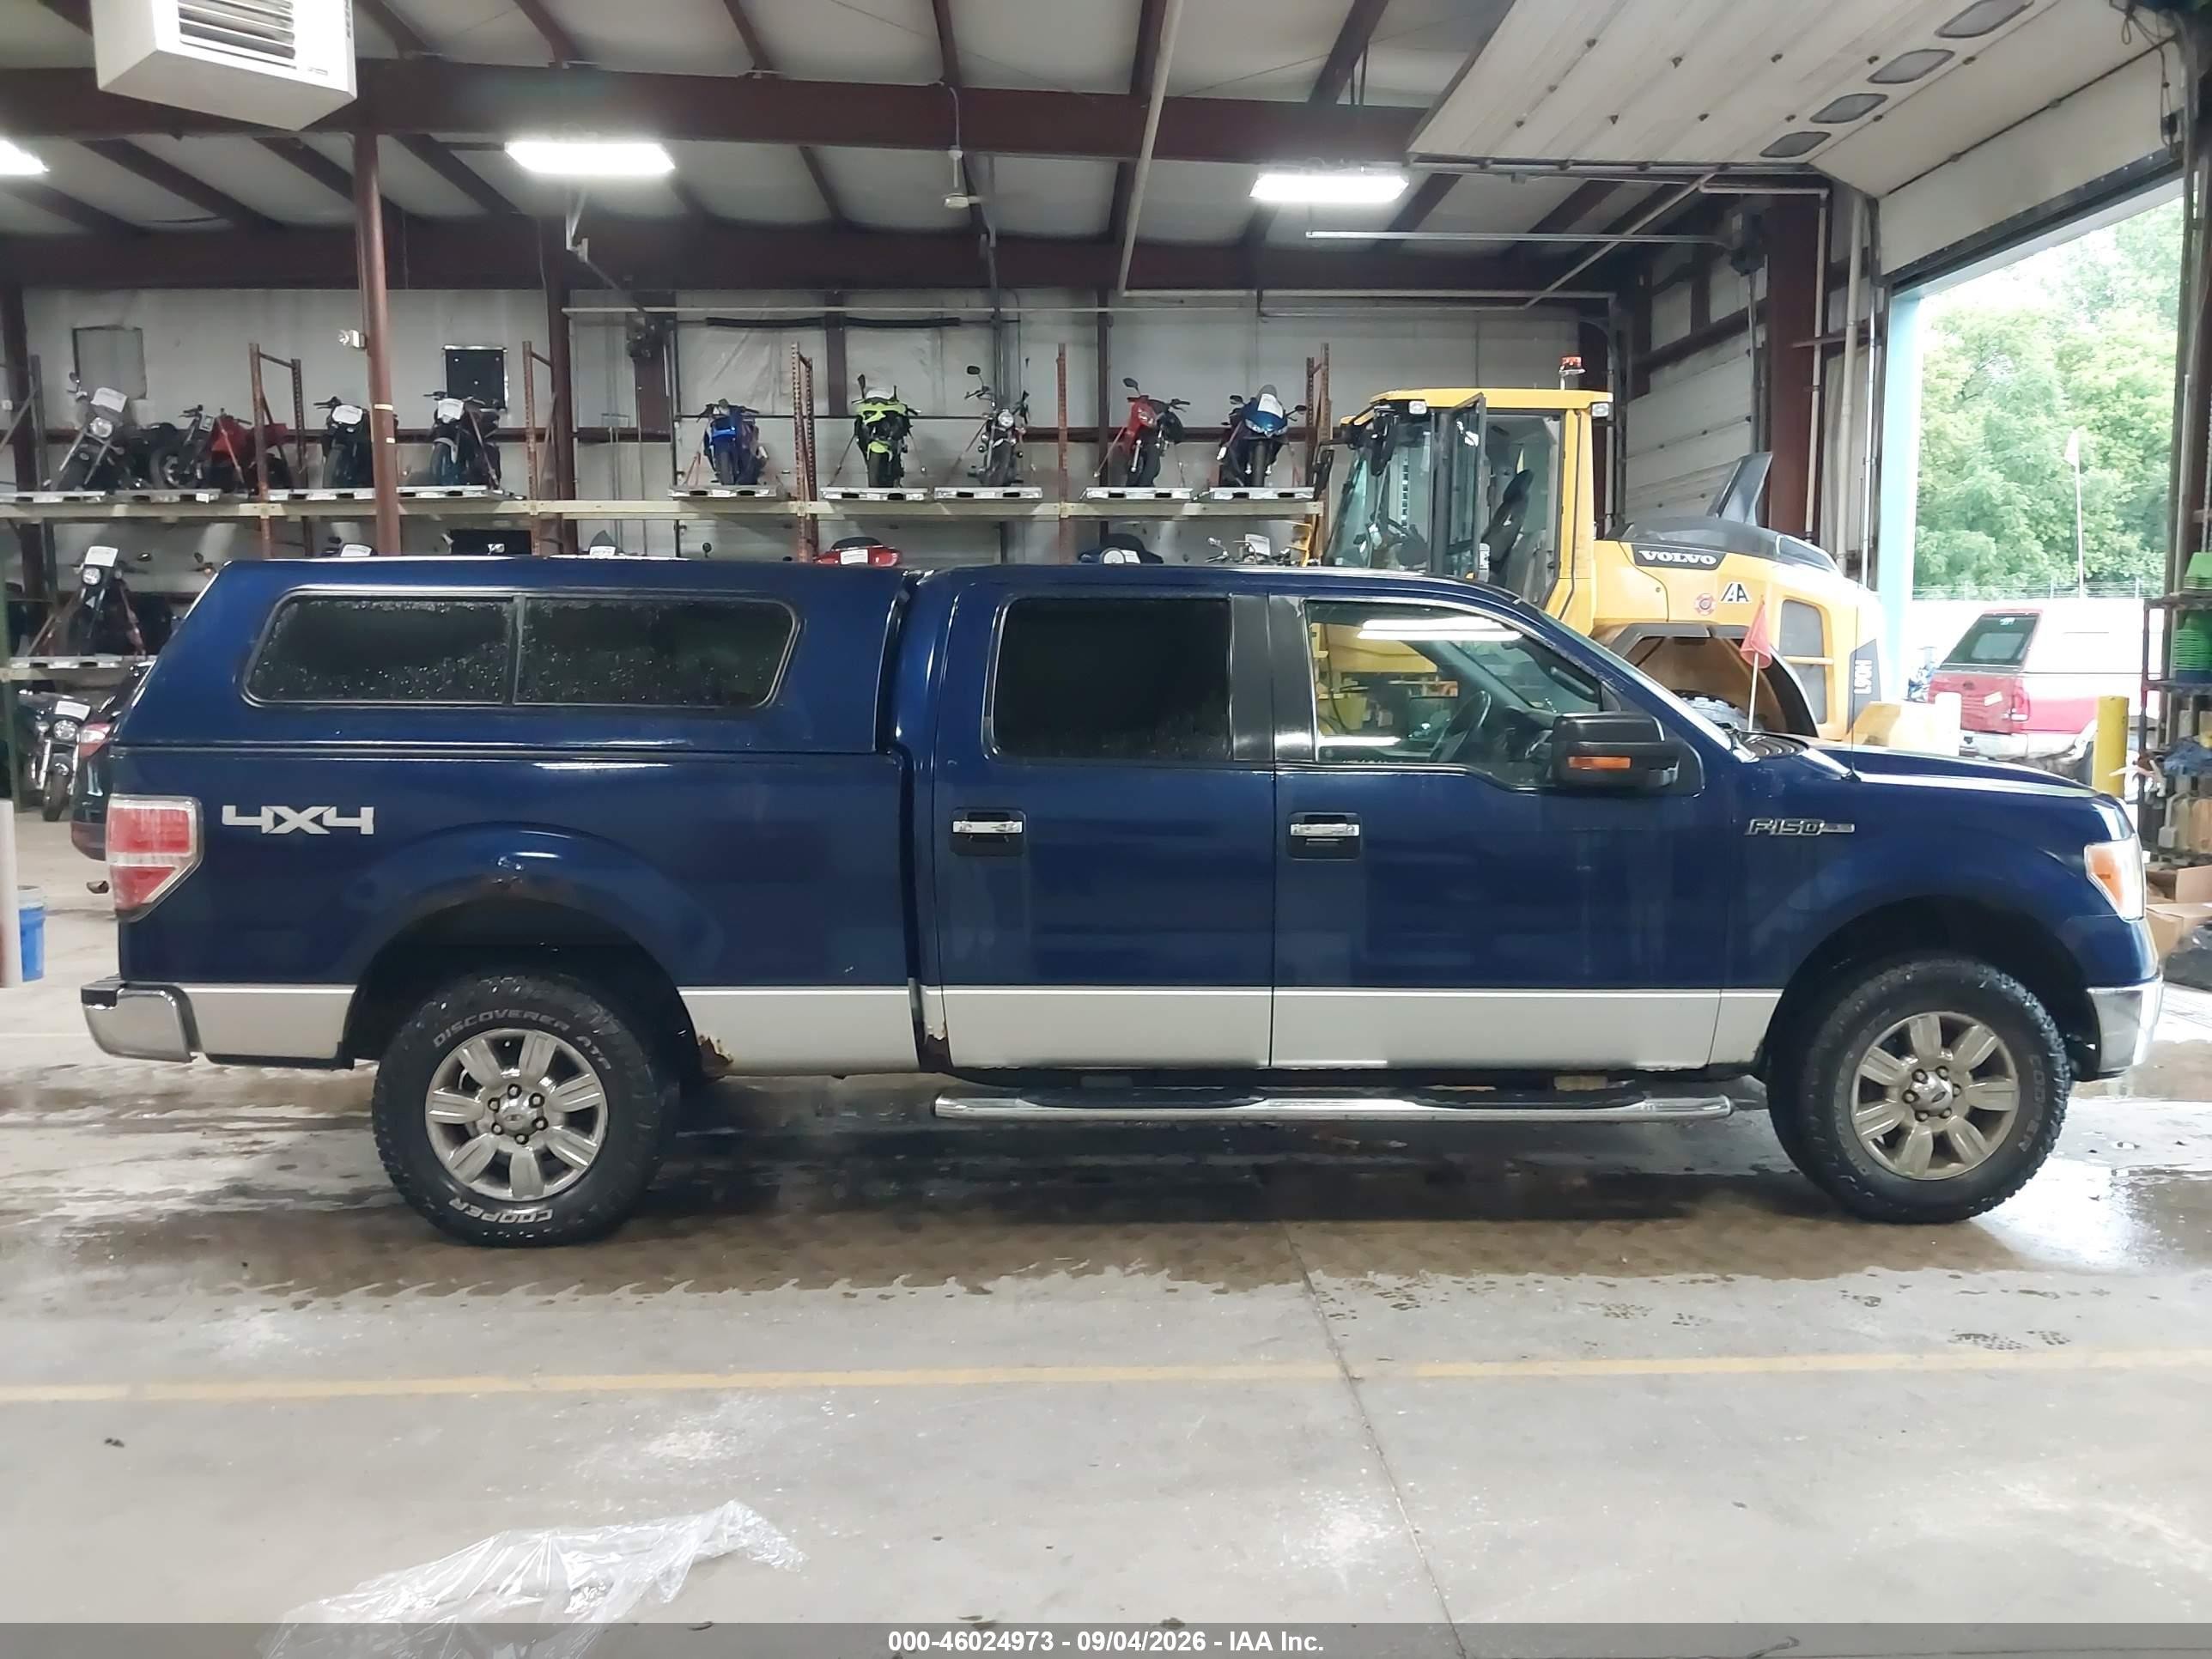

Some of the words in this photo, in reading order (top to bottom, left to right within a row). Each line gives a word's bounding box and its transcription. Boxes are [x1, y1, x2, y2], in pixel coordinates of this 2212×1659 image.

[1638, 550, 1717, 566] VOLVO
[1853, 659, 1873, 695] L90H
[432, 1008, 571, 1048] DISCOVERER
[448, 1197, 554, 1224] COOPER
